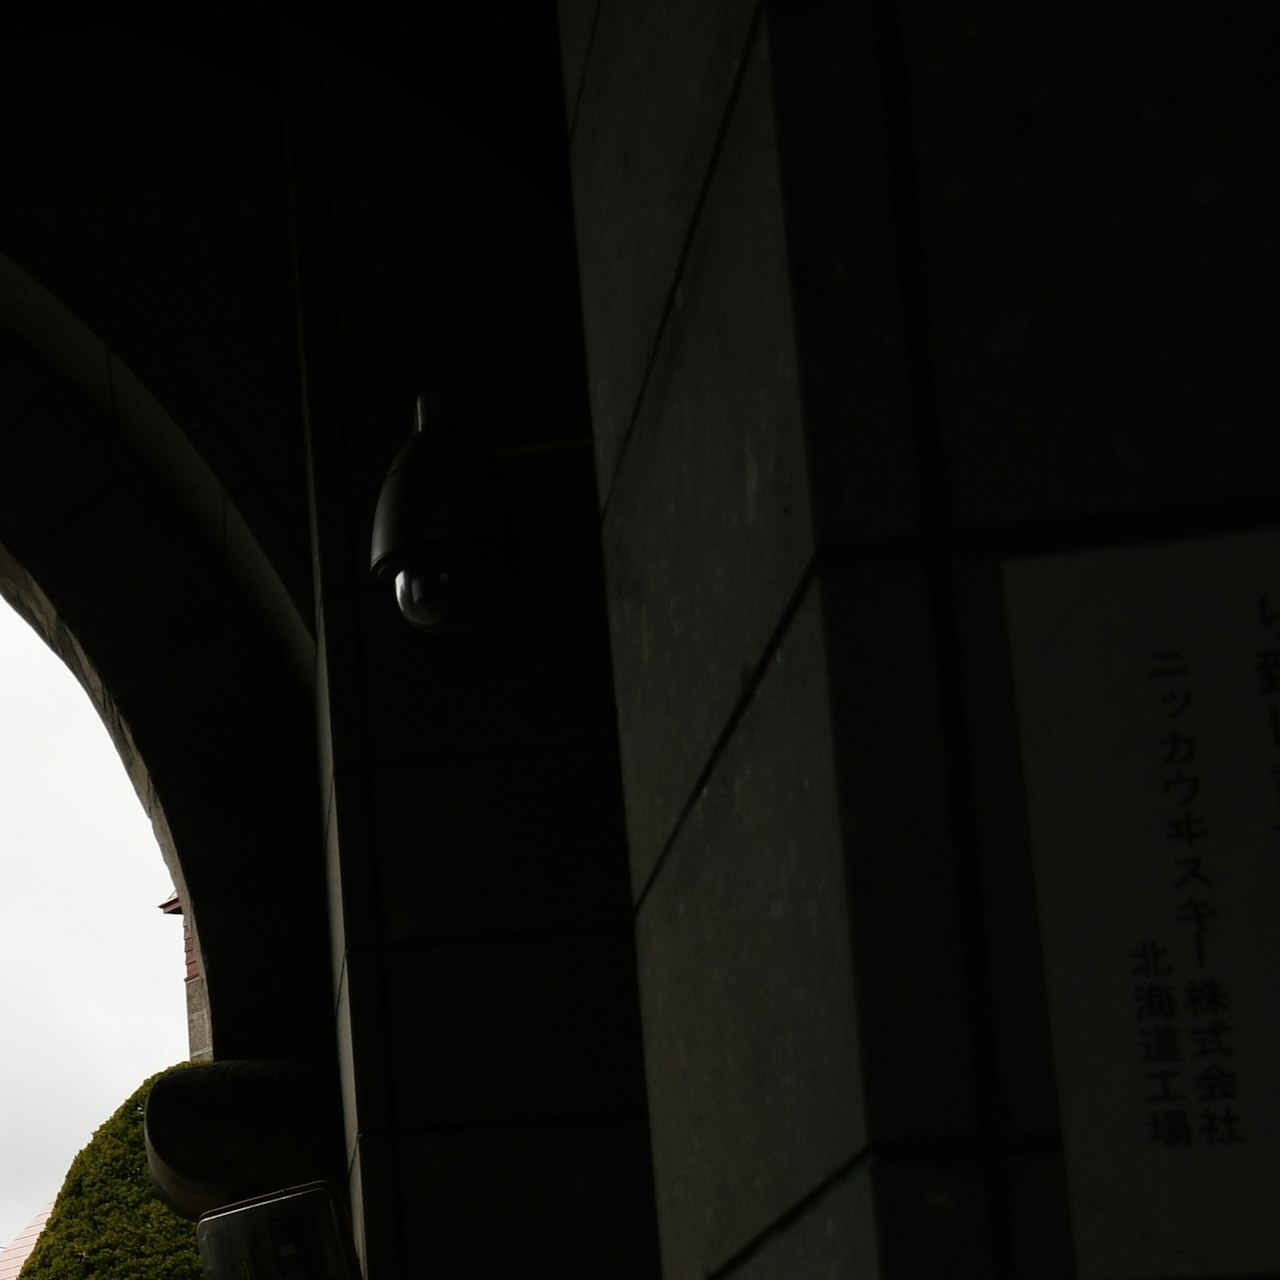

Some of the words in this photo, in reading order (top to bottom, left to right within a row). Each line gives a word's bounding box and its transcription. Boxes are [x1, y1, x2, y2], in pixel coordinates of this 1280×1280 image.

[1132, 940, 1193, 1149] 北海道工場
[1148, 651, 1244, 1149] ニッカウヰスキー株式会社
